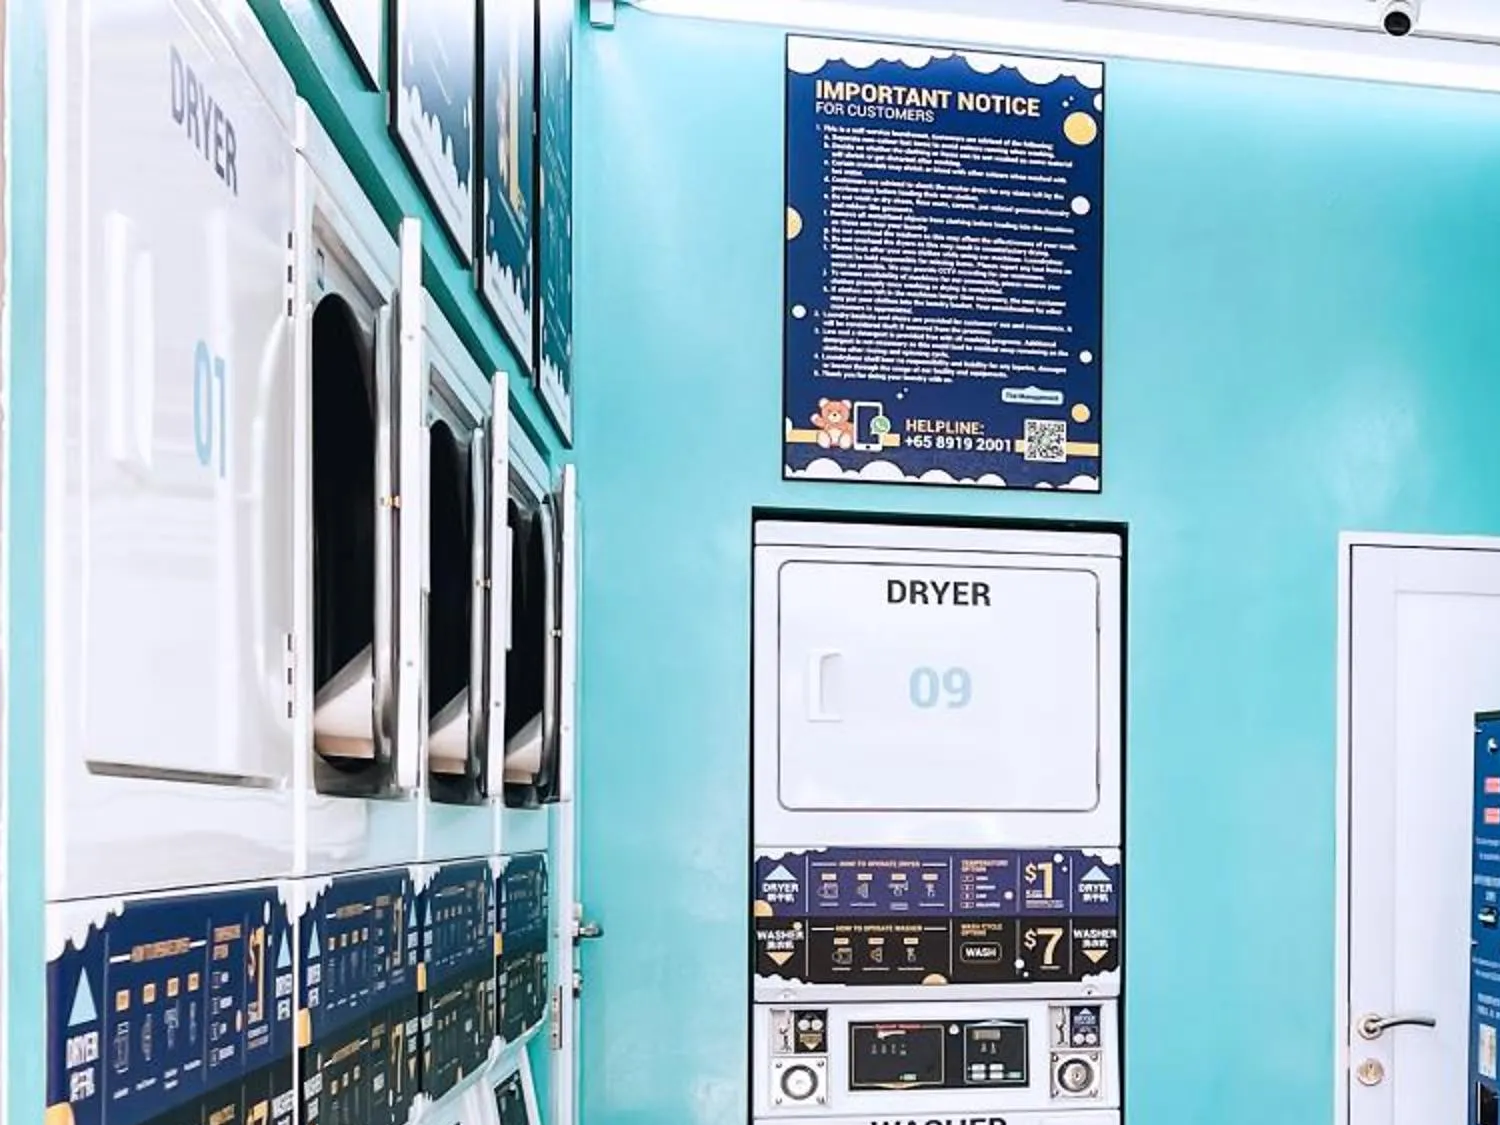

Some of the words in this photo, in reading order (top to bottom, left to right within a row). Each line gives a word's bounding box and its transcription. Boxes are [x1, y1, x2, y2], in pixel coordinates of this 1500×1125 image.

[815, 79, 952, 109] IMPORTANT
[957, 91, 1041, 118] NOTICE
[169, 45, 238, 197] DRYER
[815, 100, 845, 115] FOR
[847, 103, 935, 123] CUSTOMERS
[192, 338, 227, 480] 01
[905, 418, 985, 436] HELPLINE:
[905, 436, 933, 449] +65
[935, 437, 974, 450] 8919
[976, 437, 1012, 452] 2001
[886, 578, 992, 607] DRYER
[908, 665, 973, 710] 09
[762, 883, 799, 893] DRYER
[1023, 861, 1054, 899] $1
[1078, 883, 1113, 893] DRYER
[757, 930, 804, 940] WASHER
[1073, 929, 1117, 939] WASHER
[965, 946, 997, 957] WASH
[1023, 927, 1064, 965] $7
